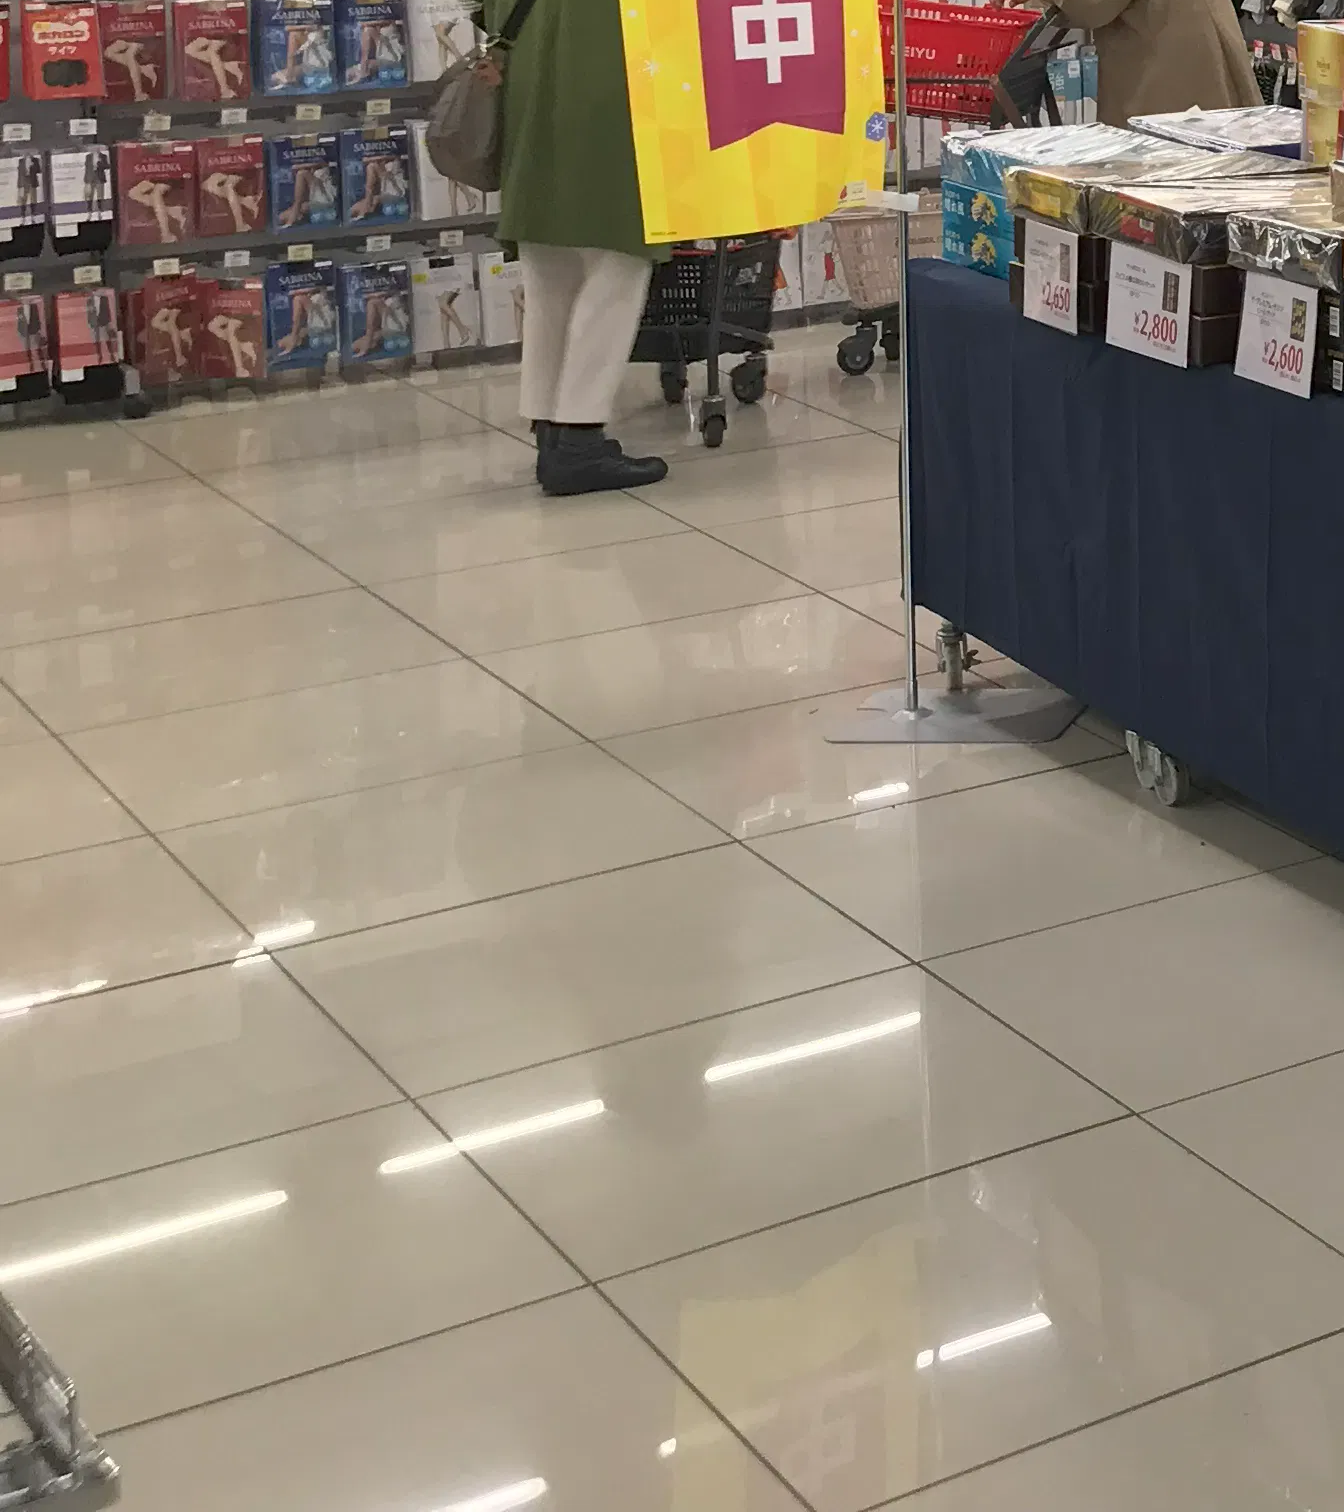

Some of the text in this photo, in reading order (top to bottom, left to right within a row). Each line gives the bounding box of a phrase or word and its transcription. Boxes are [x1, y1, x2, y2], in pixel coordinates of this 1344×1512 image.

[890, 44, 936, 60] SEIYU
[1134, 311, 1178, 345] ¥2,800
[1263, 339, 1304, 374] ¥2,600
